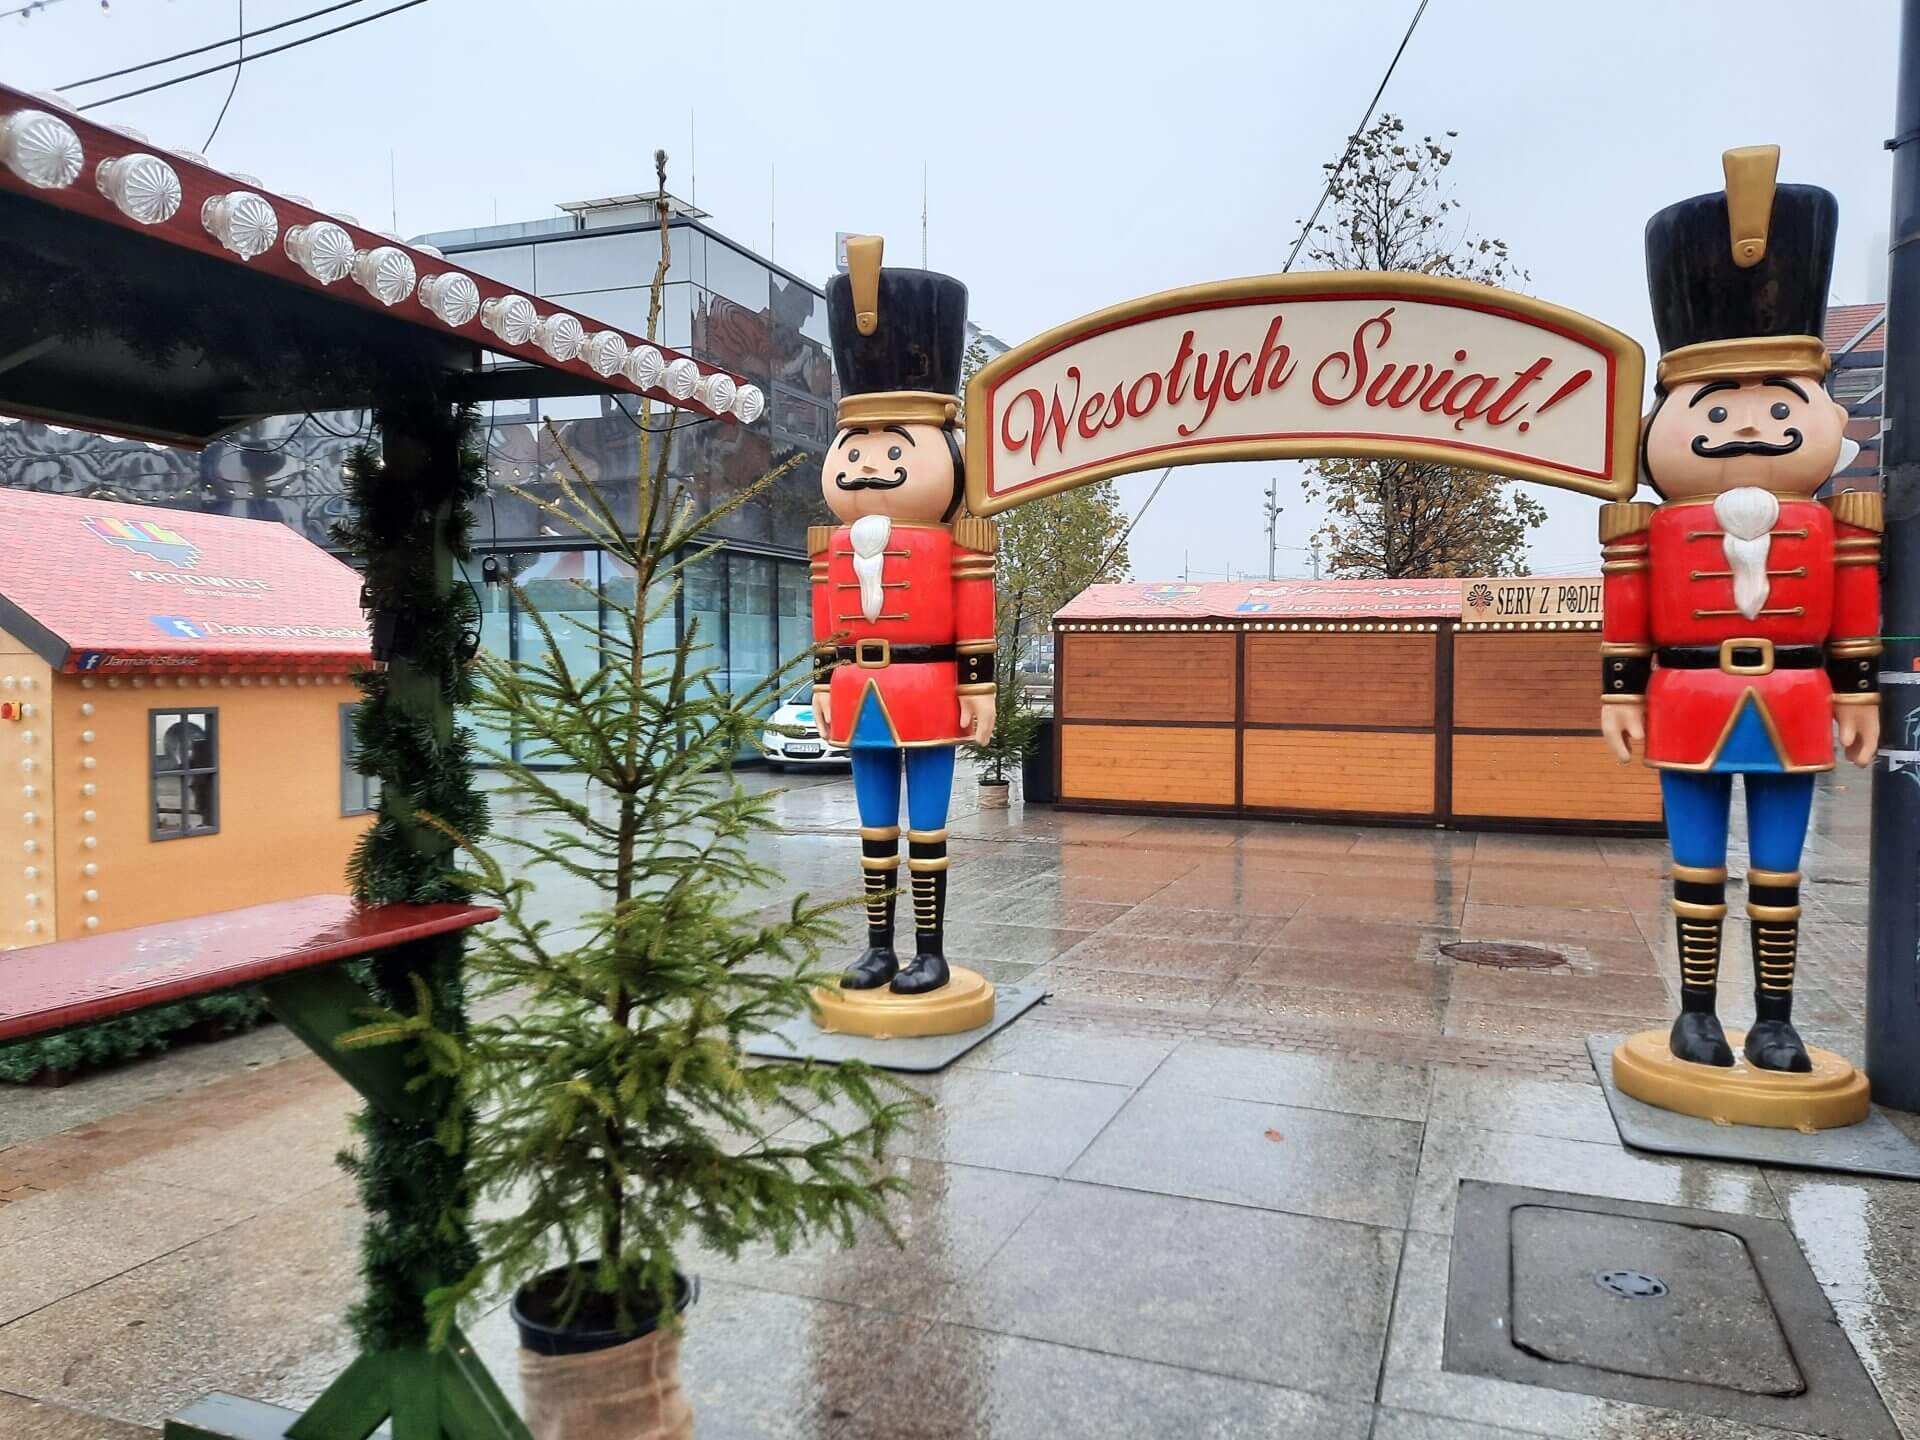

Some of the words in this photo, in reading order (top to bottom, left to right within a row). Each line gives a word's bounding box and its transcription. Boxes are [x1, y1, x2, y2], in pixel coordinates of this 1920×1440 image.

[1001, 315, 1299, 466] Wesołych
[1311, 306, 1593, 433] Świąt!
[128, 570, 277, 591] KATOWICE
[1496, 587, 1536, 615] SERY
[1539, 587, 1551, 614] Z
[1556, 585, 1604, 613] PODH
